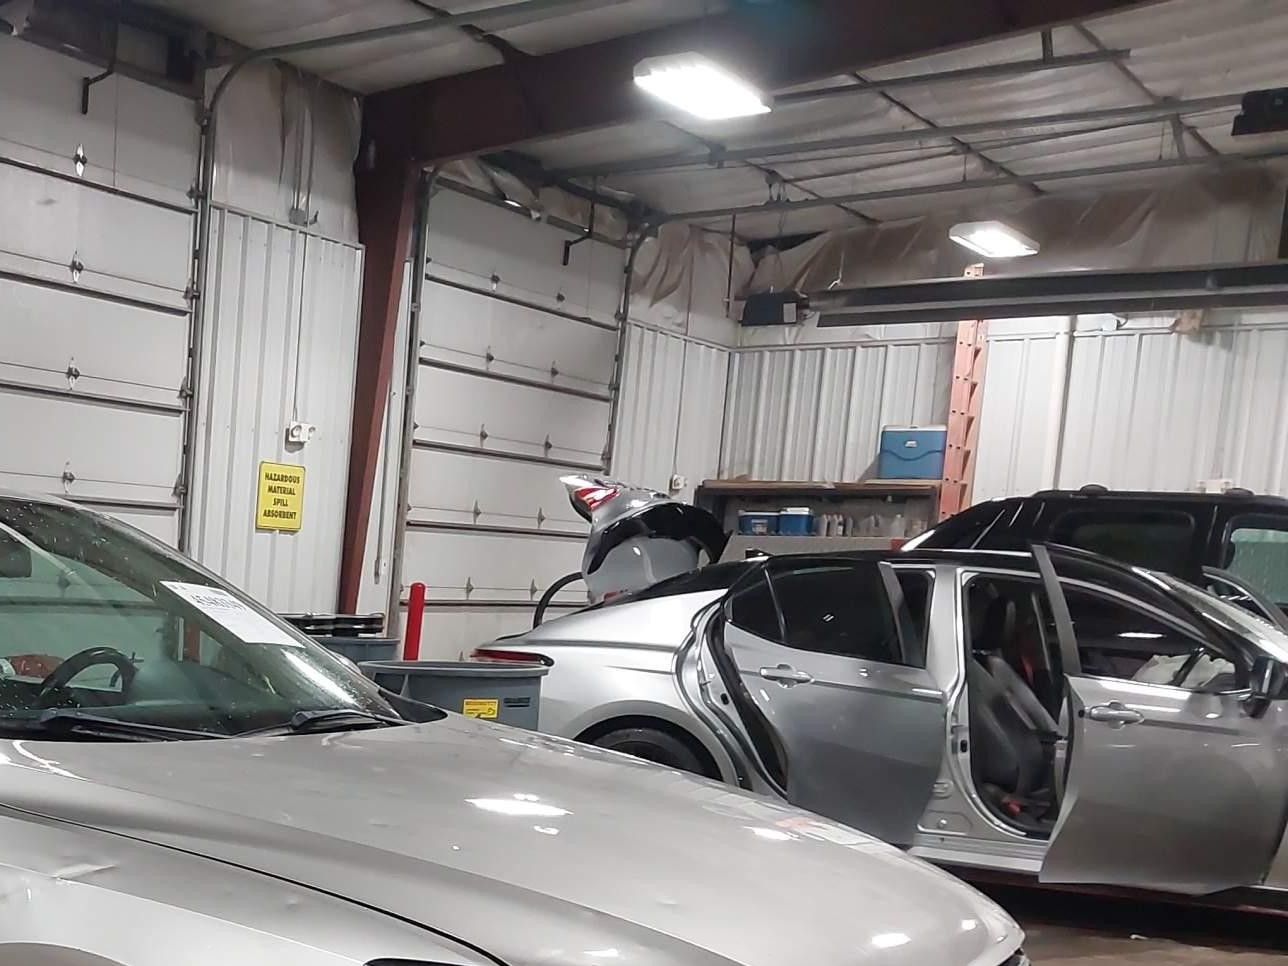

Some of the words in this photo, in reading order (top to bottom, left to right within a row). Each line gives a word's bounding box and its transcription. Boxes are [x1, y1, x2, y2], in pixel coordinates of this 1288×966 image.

[264, 472, 300, 484] HAZARDOUS
[267, 485, 296, 496] MATERIAL
[272, 497, 289, 507] SPILL
[263, 509, 297, 520] ABSORBENT
